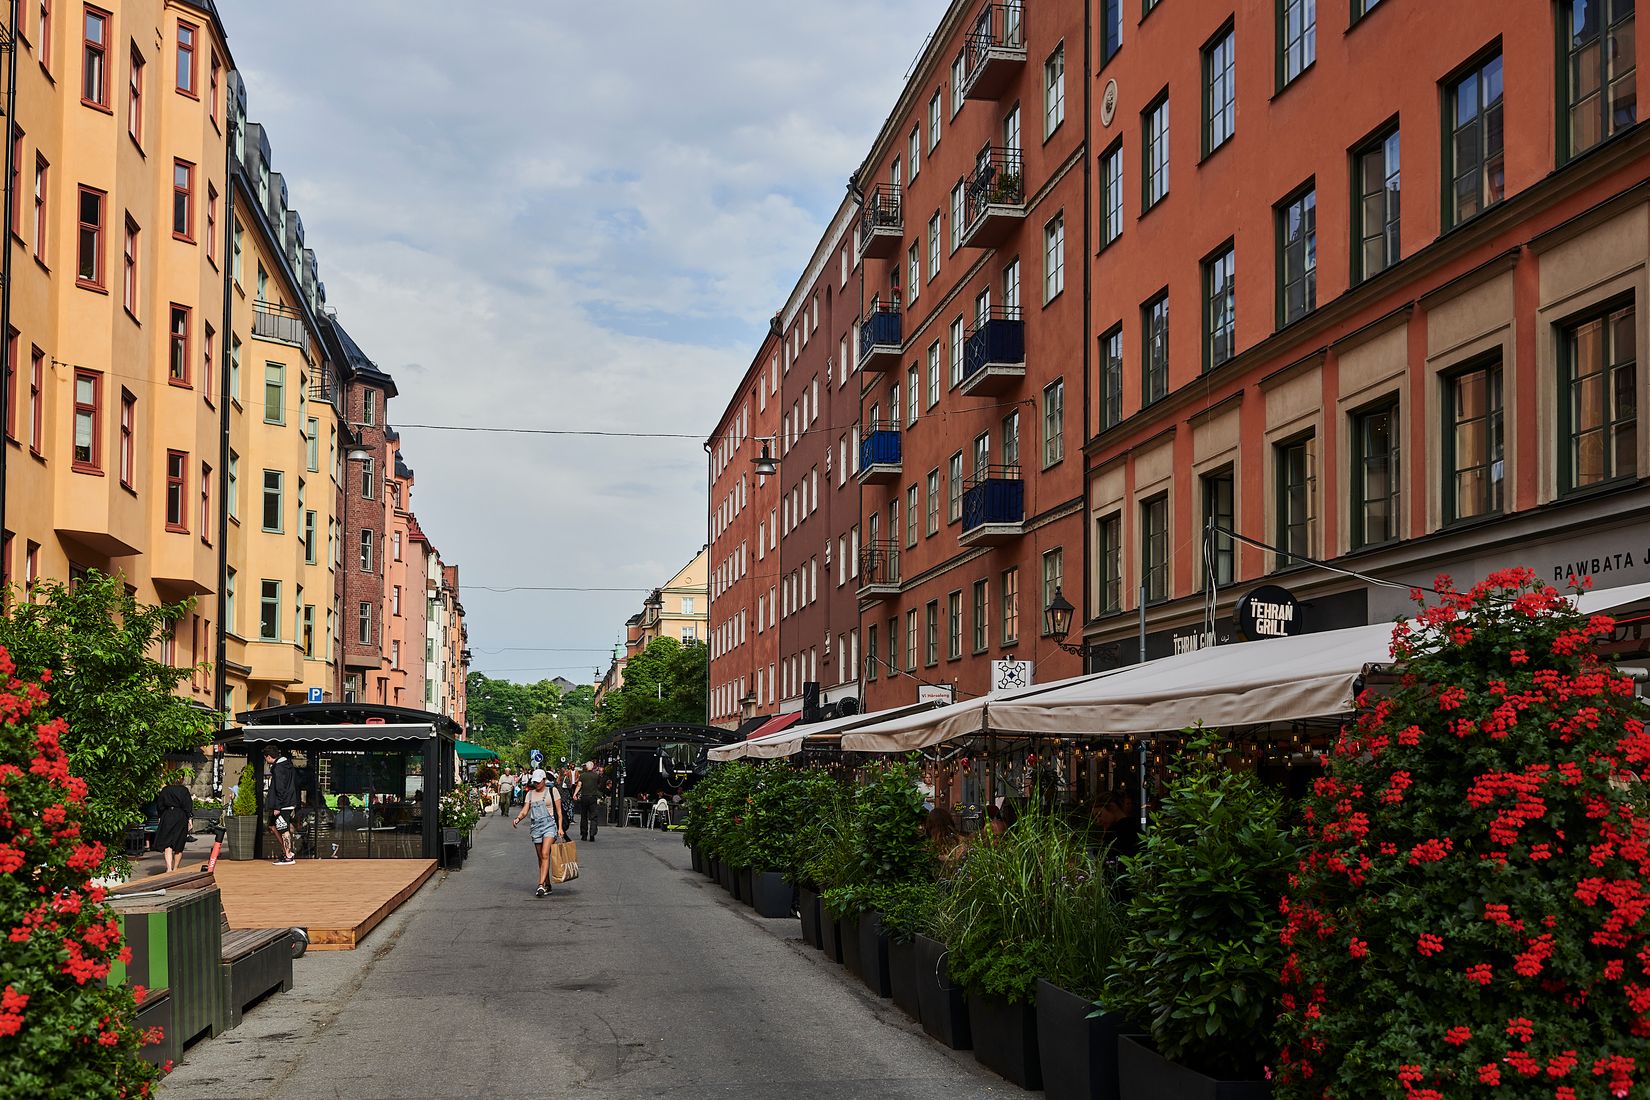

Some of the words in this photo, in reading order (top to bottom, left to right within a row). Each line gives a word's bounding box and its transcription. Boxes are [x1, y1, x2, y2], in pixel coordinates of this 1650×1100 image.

[1554, 552, 1634, 581] RAWBATA
[1256, 618, 1288, 636] GRILL
[312, 688, 320, 701] P
